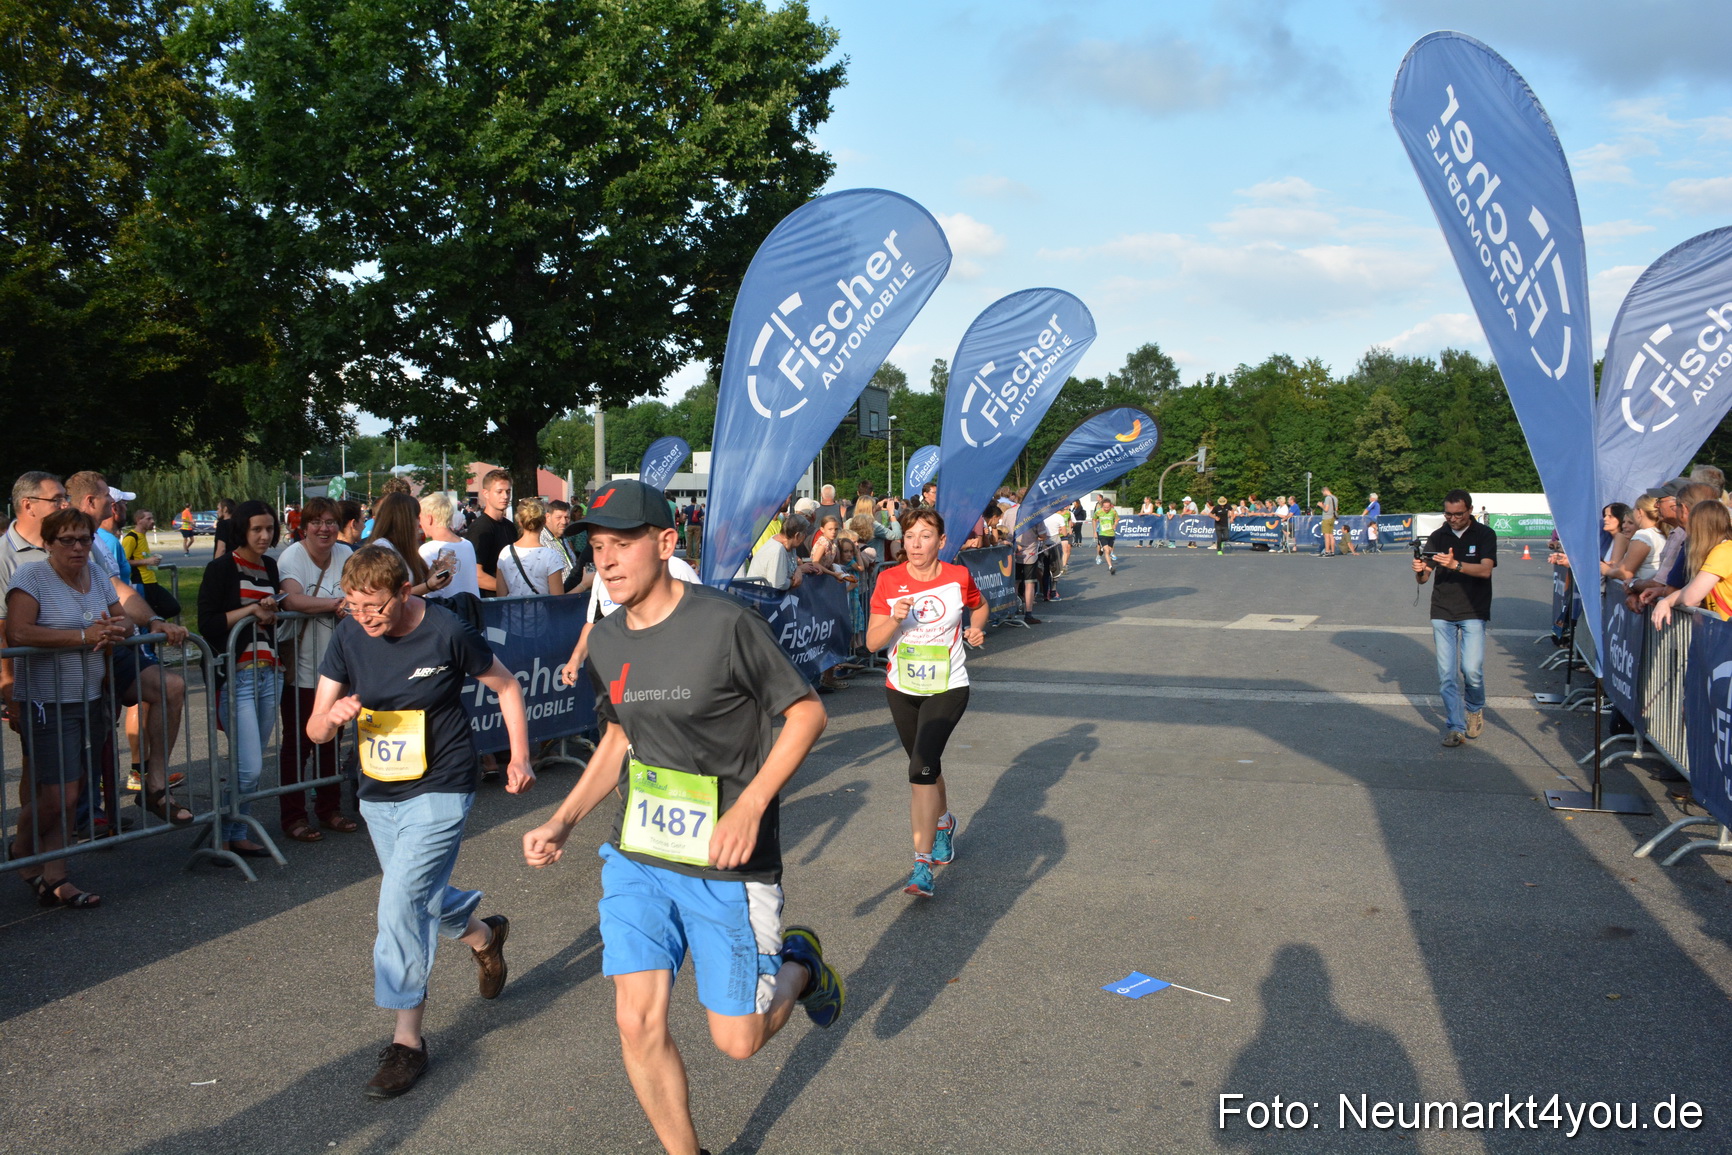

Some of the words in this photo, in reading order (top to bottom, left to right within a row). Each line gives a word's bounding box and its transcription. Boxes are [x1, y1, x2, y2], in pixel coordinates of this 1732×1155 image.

[777, 229, 902, 391] Fischer
[821, 261, 916, 390] AUTOMOBILE
[980, 313, 1063, 428] Fischer
[1009, 334, 1073, 426] AUTOMOBILE
[1691, 343, 1732, 406] AUTO
[651, 444, 680, 481] Fischer
[914, 451, 938, 482] Fischer
[1038, 443, 1125, 495] Frischmann
[1093, 458, 1115, 474] Druck
[1115, 450, 1129, 462] und
[1128, 437, 1154, 456] Medien
[1120, 525, 1152, 533] Fischer
[1185, 526, 1216, 534] Fischer
[1231, 523, 1266, 532] Frischmann
[1493, 518, 1512, 529] AOK
[779, 616, 835, 649] Fischer
[791, 643, 827, 664] UTOMOBILE
[907, 663, 936, 680] 541
[623, 685, 691, 703] duerrer.de
[471, 696, 575, 732] AUTMOBILE
[366, 736, 407, 762] 767
[637, 799, 707, 838] 1487
